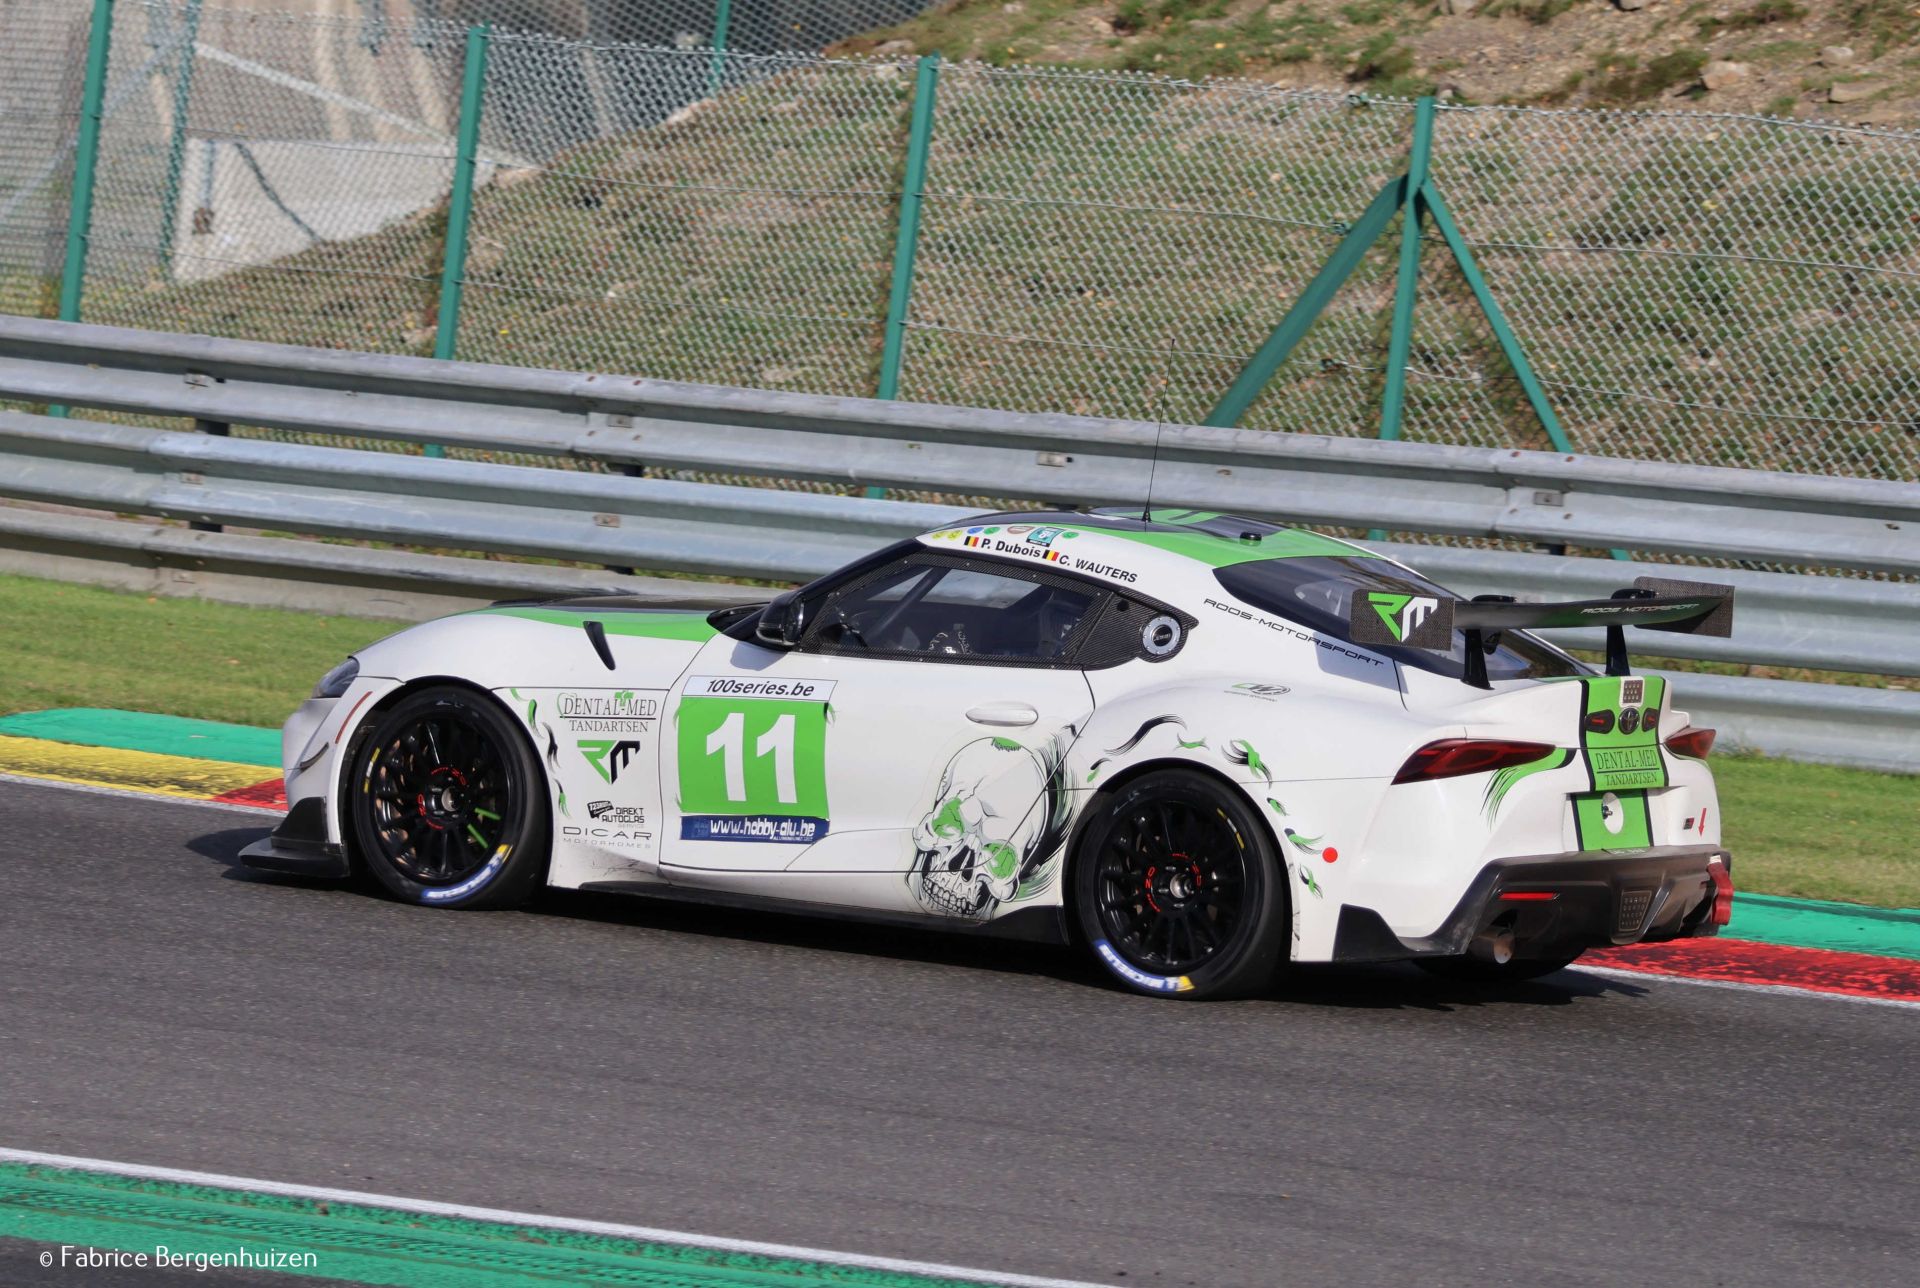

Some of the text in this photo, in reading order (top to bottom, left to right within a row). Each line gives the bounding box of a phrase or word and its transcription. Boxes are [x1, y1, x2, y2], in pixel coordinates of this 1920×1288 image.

[981, 538, 991, 549] P.
[995, 541, 1041, 558] Dubois
[1059, 554, 1138, 583] C. WAUTERS
[1203, 598, 1385, 666] ROOS-MOTORSPORT
[706, 679, 815, 697] 100series.be
[564, 697, 657, 716] DENTAL-MED
[569, 719, 649, 733] TANDARTSEN
[706, 712, 798, 804] 11
[1595, 749, 1658, 770] DENTAL-MED
[1604, 772, 1658, 787] TANDARTSEN
[615, 807, 644, 815] DIREKT
[563, 826, 652, 840] DICAR
[710, 817, 816, 839] www.hobby-alu.be
